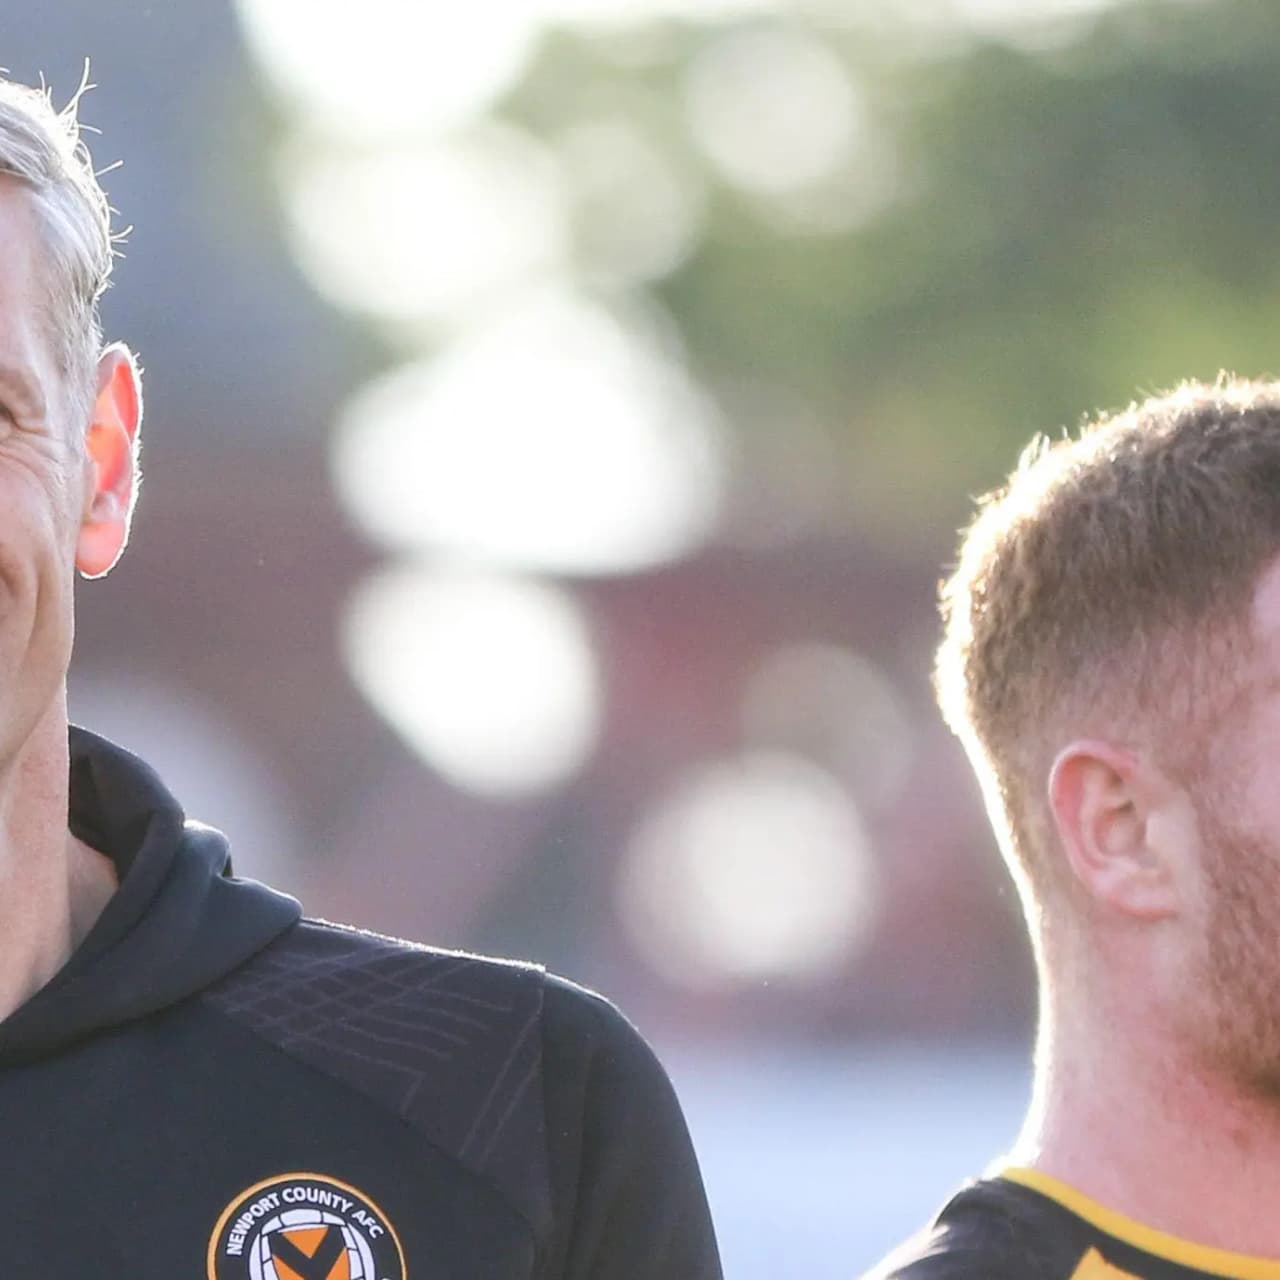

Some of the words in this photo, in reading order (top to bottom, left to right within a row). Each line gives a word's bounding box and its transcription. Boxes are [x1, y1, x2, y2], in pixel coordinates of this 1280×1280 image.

[226, 1192, 280, 1256] NEWPORT
[281, 1186, 354, 1214] COUNTY
[352, 1209, 385, 1239] AFC
